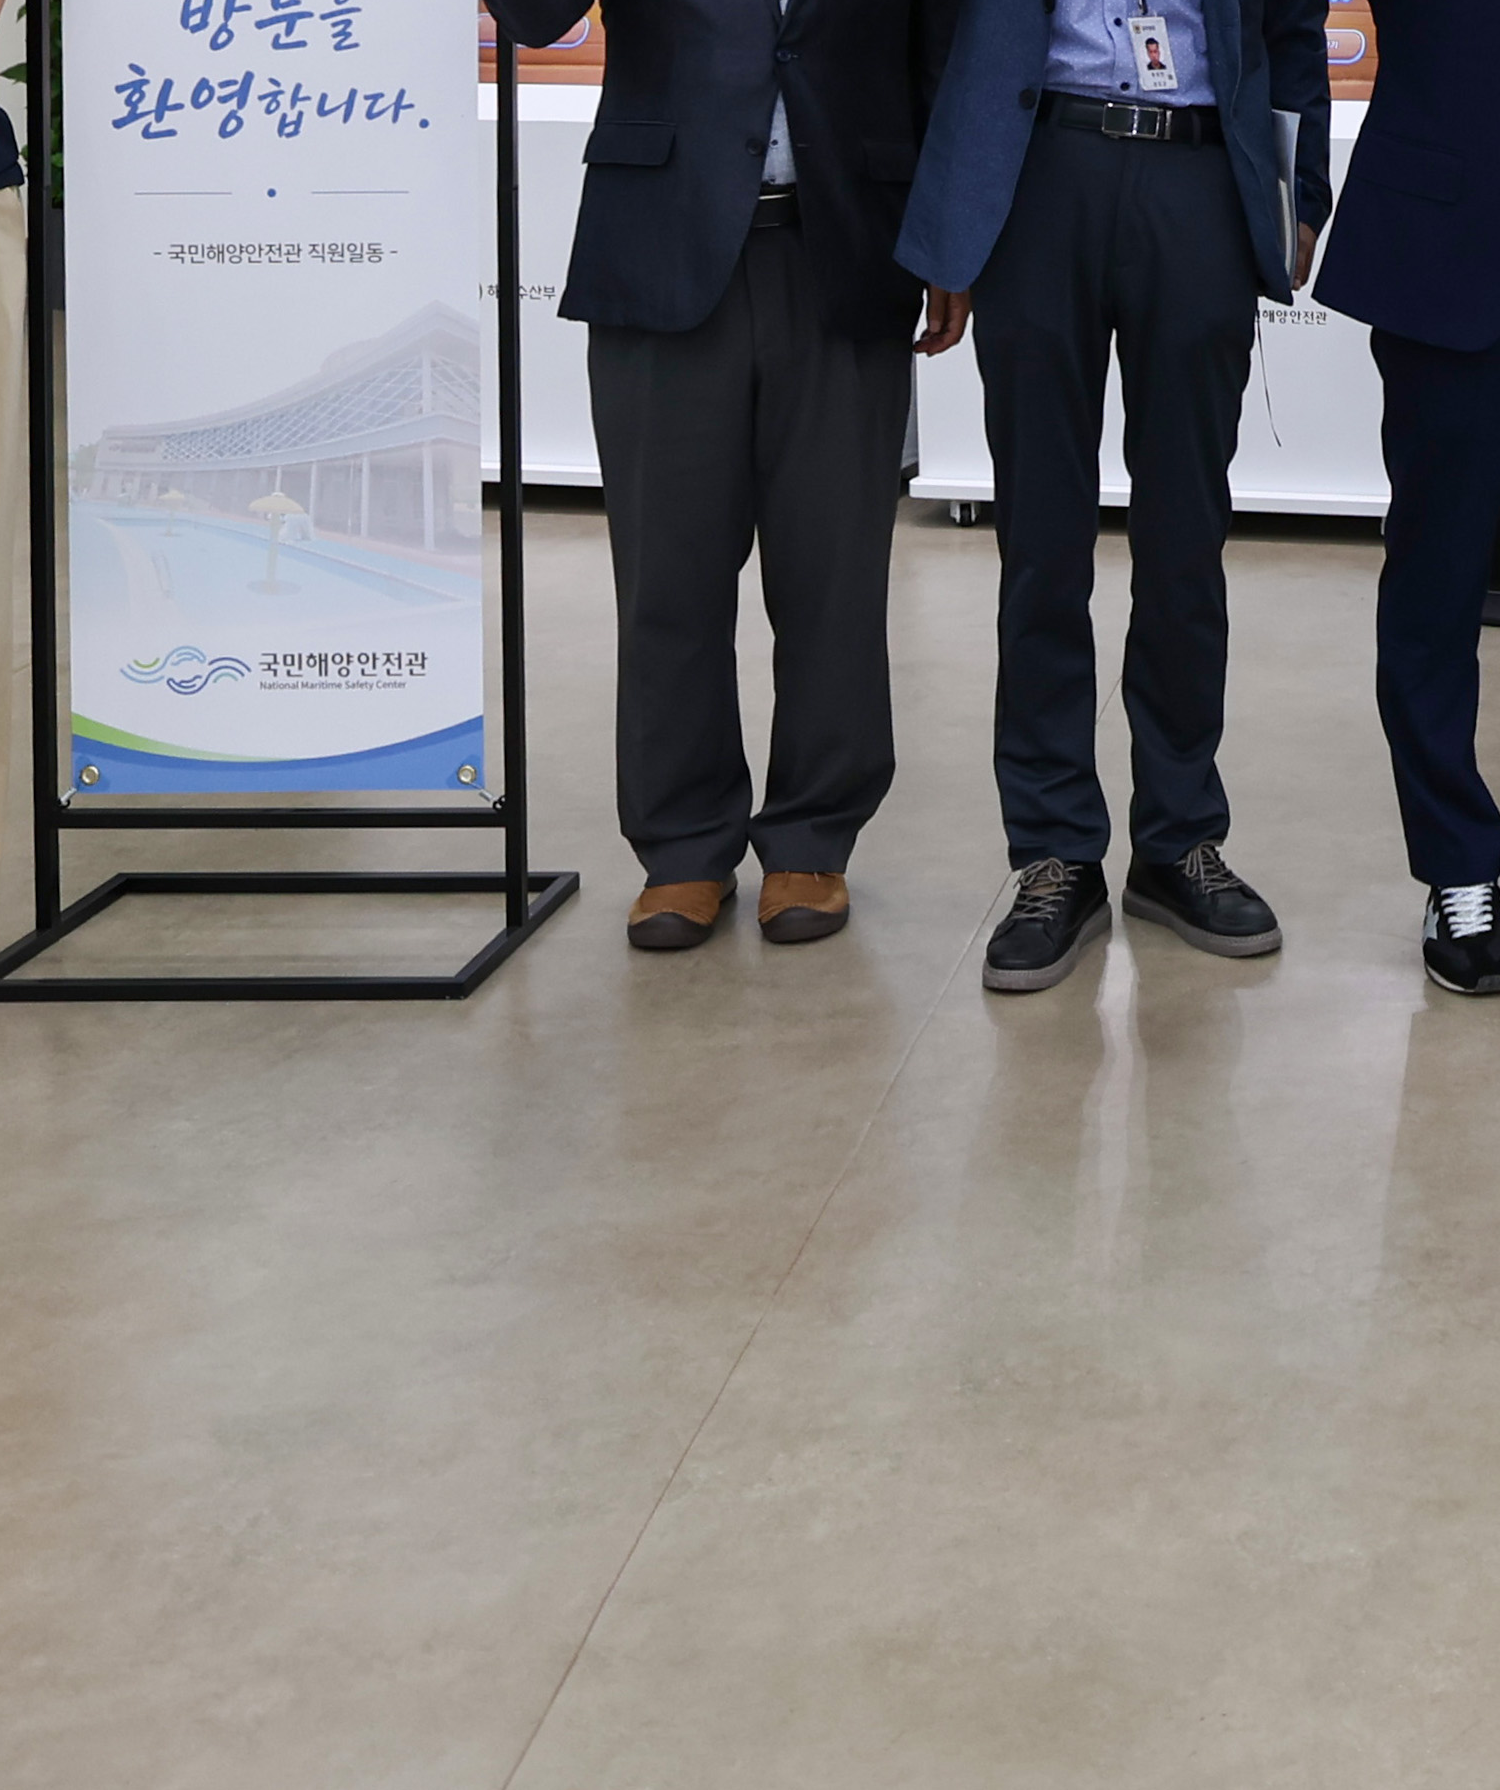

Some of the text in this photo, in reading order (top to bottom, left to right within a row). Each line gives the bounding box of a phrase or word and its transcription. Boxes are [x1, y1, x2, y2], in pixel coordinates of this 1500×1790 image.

[111, 62, 430, 140] 환영합니다.
[167, 244, 303, 265] 국민해양안전관
[308, 243, 384, 264] 직원일동
[258, 651, 429, 678] 국민해양안전관
[259, 680, 407, 692] National Maritime Safety Center
